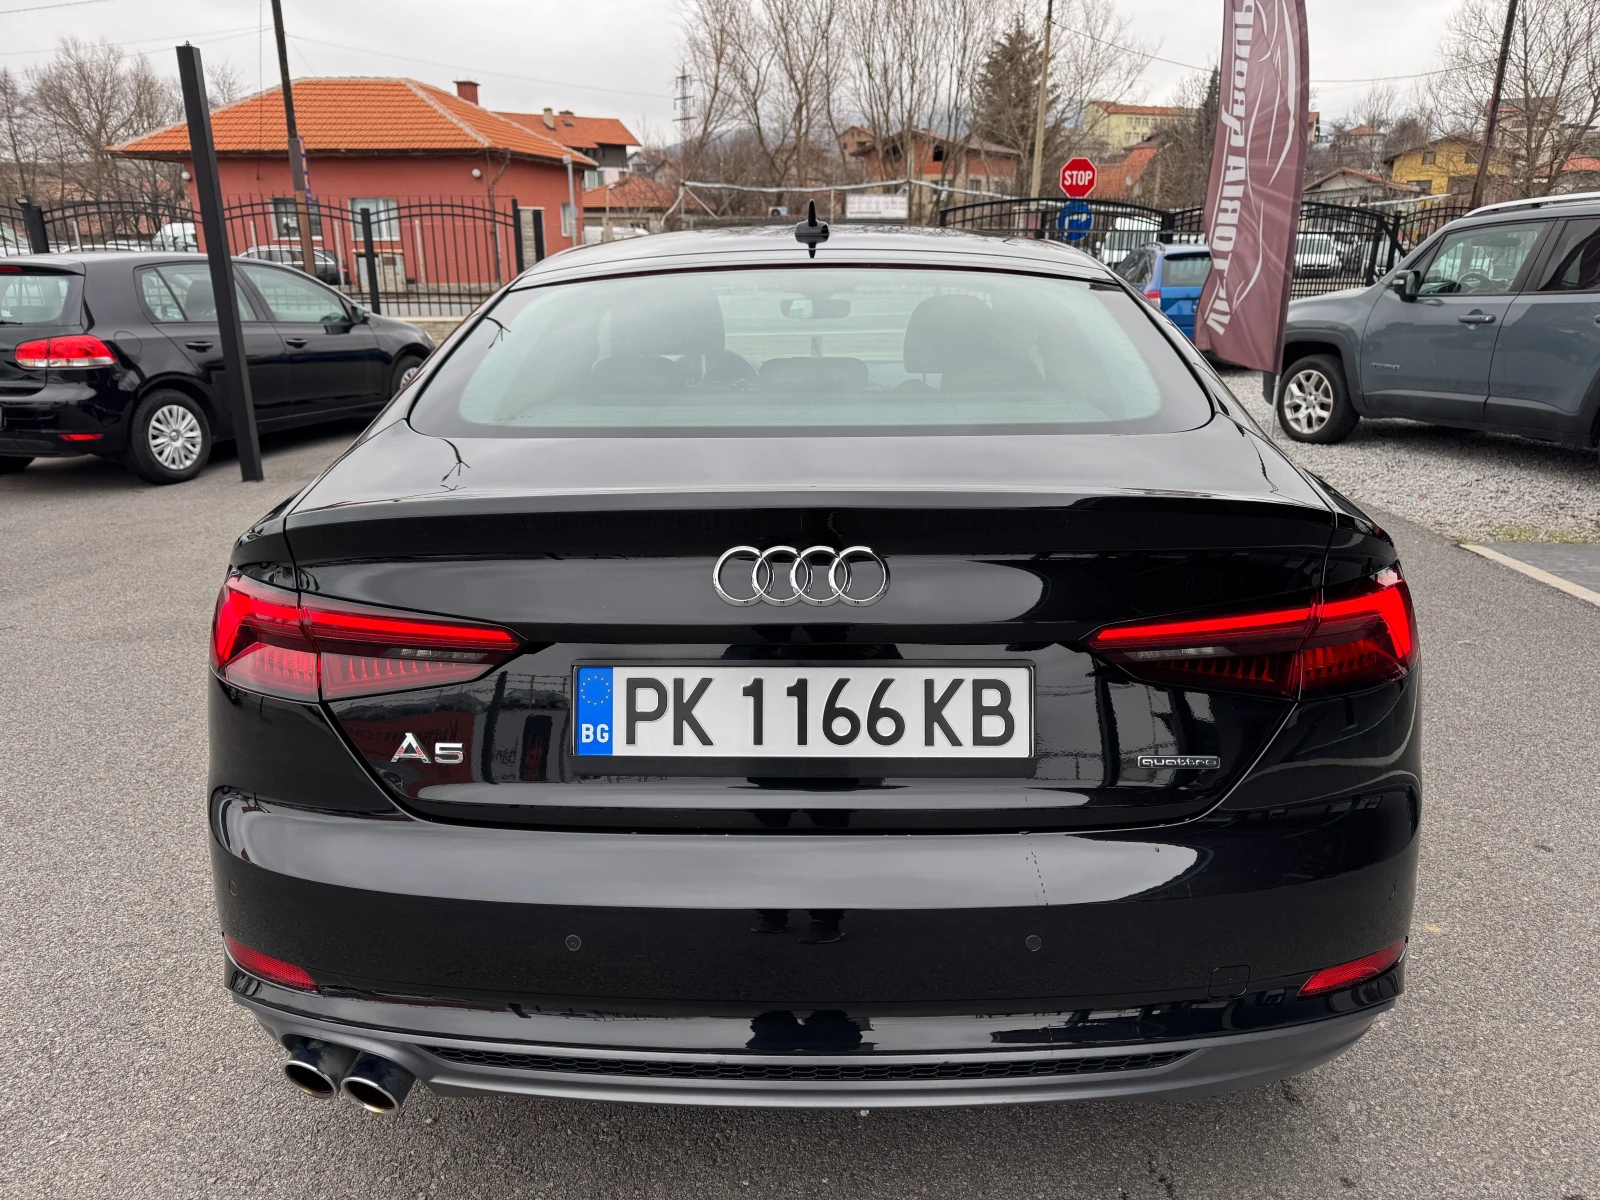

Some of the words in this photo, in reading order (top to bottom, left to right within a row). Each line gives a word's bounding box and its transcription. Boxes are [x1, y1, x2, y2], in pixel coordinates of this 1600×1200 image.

[1064, 170, 1093, 186] STOP
[626, 677, 714, 746] PK
[742, 677, 906, 747] 1166
[924, 678, 1015, 747] KB
[581, 723, 610, 743] BG
[390, 732, 464, 764] A5
[1141, 757, 1217, 768] quattro
